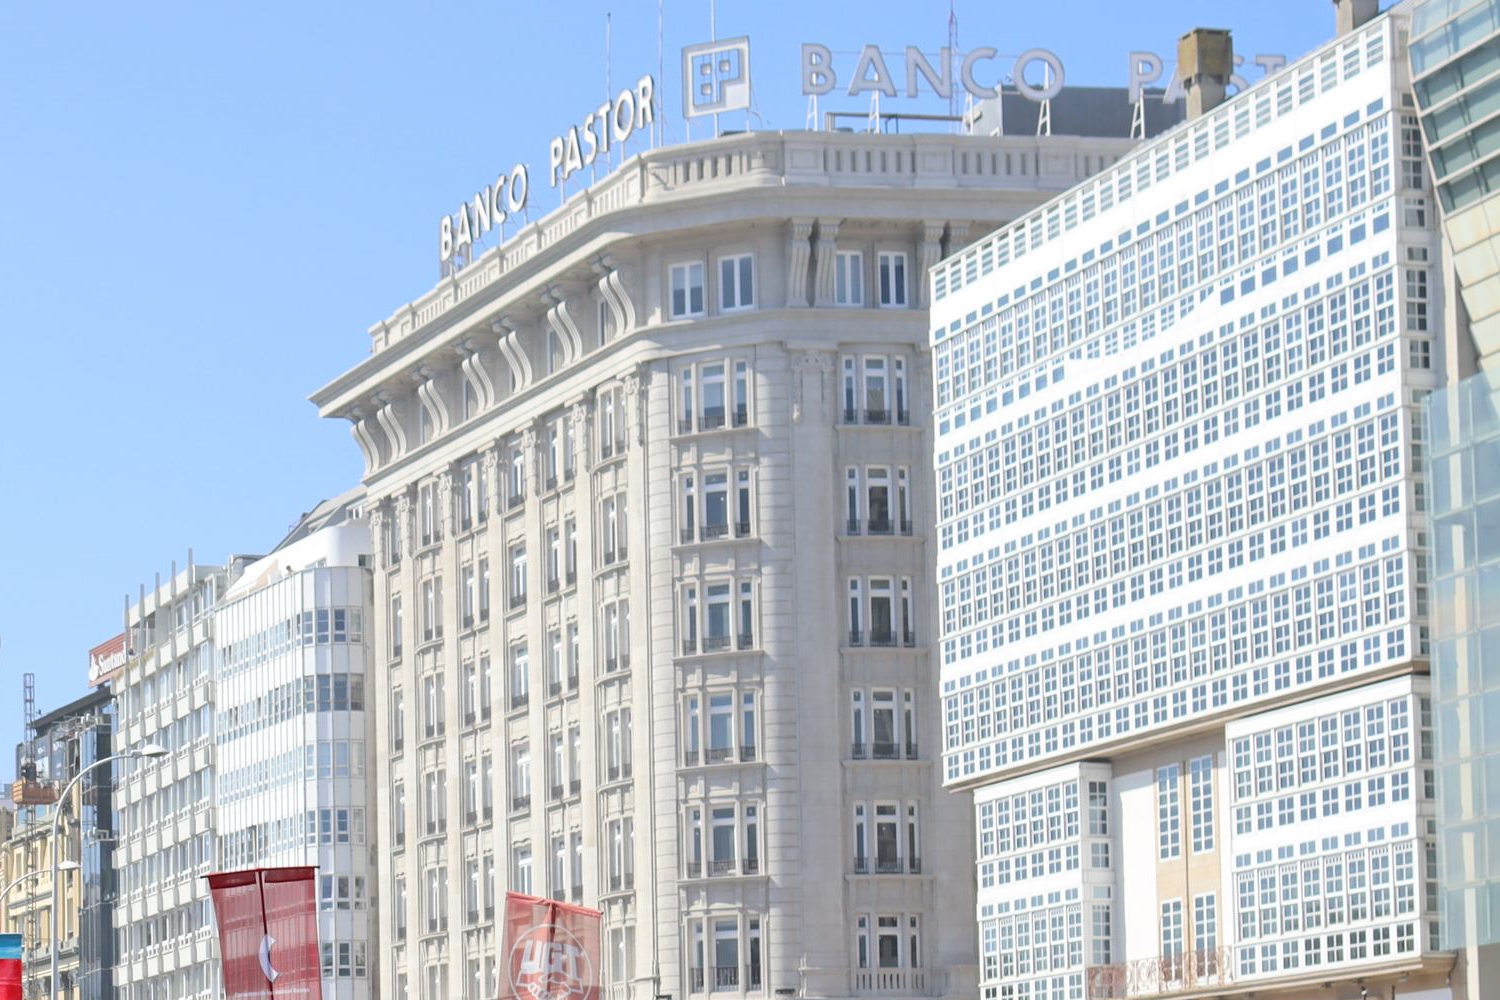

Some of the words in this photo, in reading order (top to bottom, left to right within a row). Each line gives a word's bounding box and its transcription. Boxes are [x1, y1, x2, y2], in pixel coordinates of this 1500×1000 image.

[800, 43, 1065, 100] BANCO
[440, 162, 529, 261] BANCO
[550, 74, 654, 188] PASTOR
[520, 938, 582, 981] UGT
